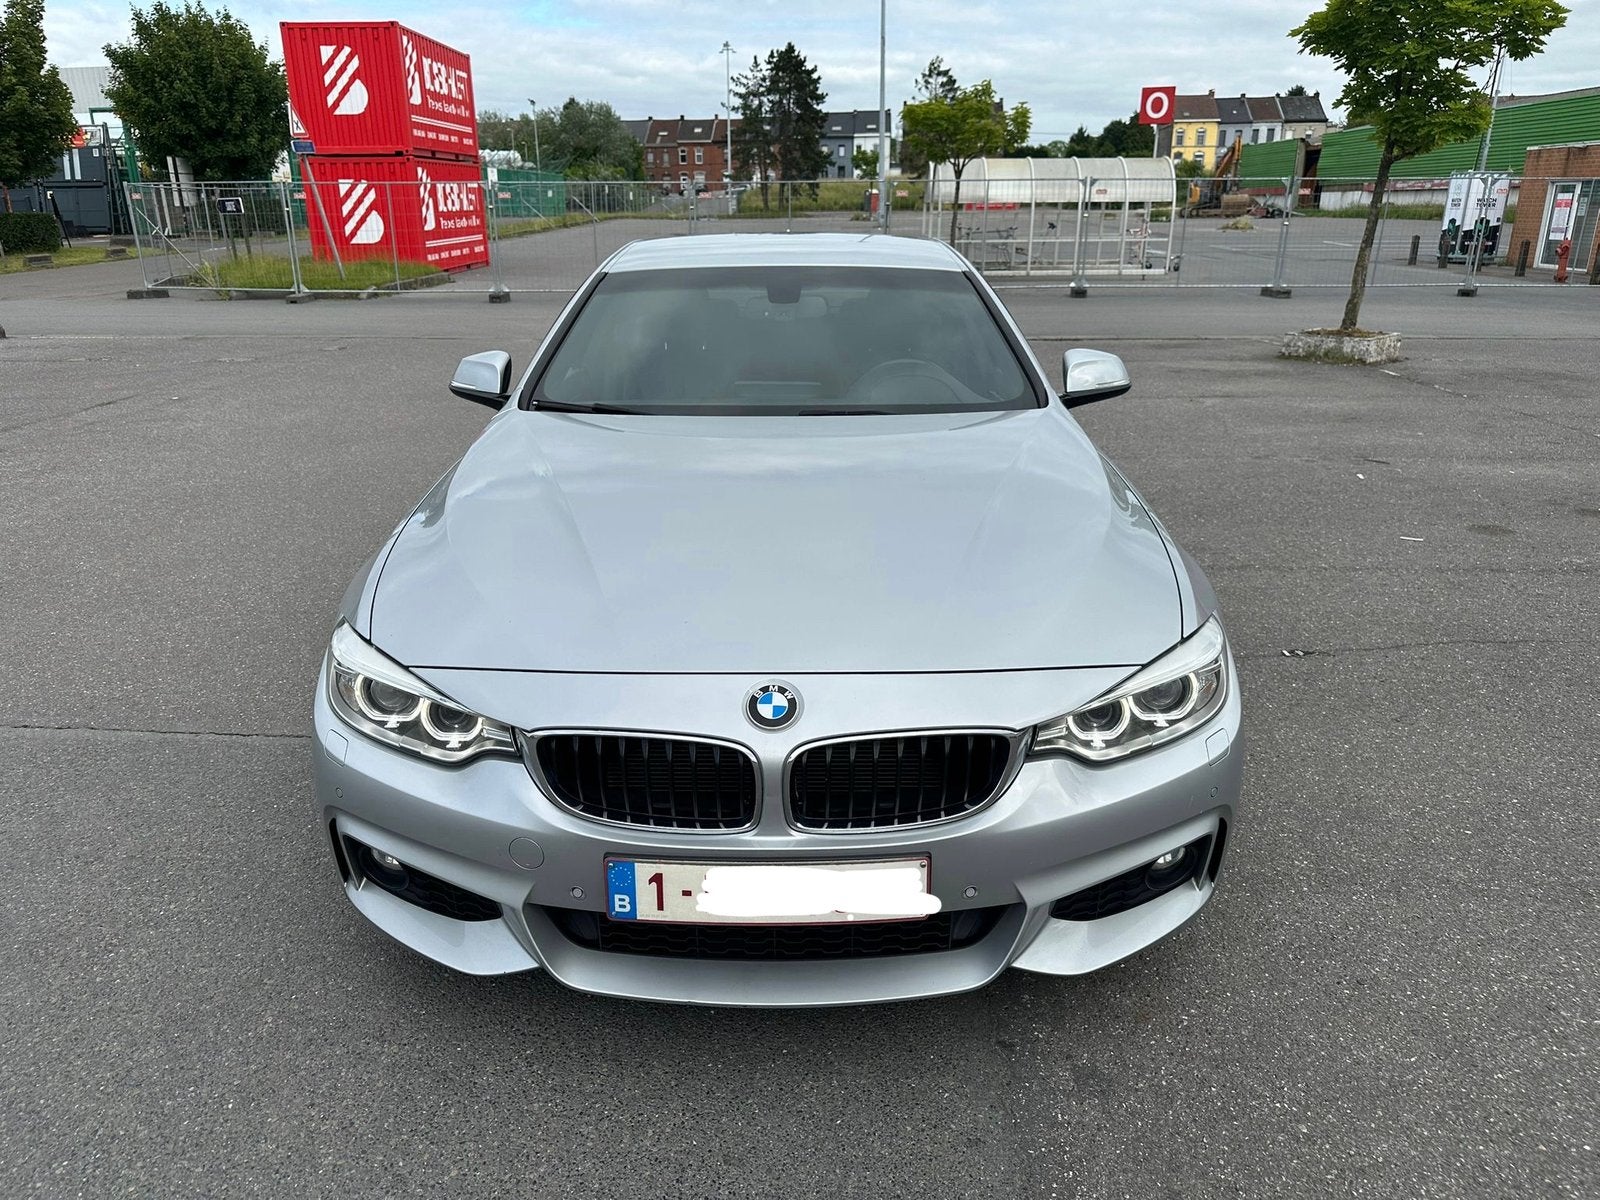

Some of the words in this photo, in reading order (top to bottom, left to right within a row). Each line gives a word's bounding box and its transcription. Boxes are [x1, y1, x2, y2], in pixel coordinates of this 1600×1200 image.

[1145, 91, 1169, 119] O
[753, 685, 795, 700] BMW
[614, 894, 631, 913] B
